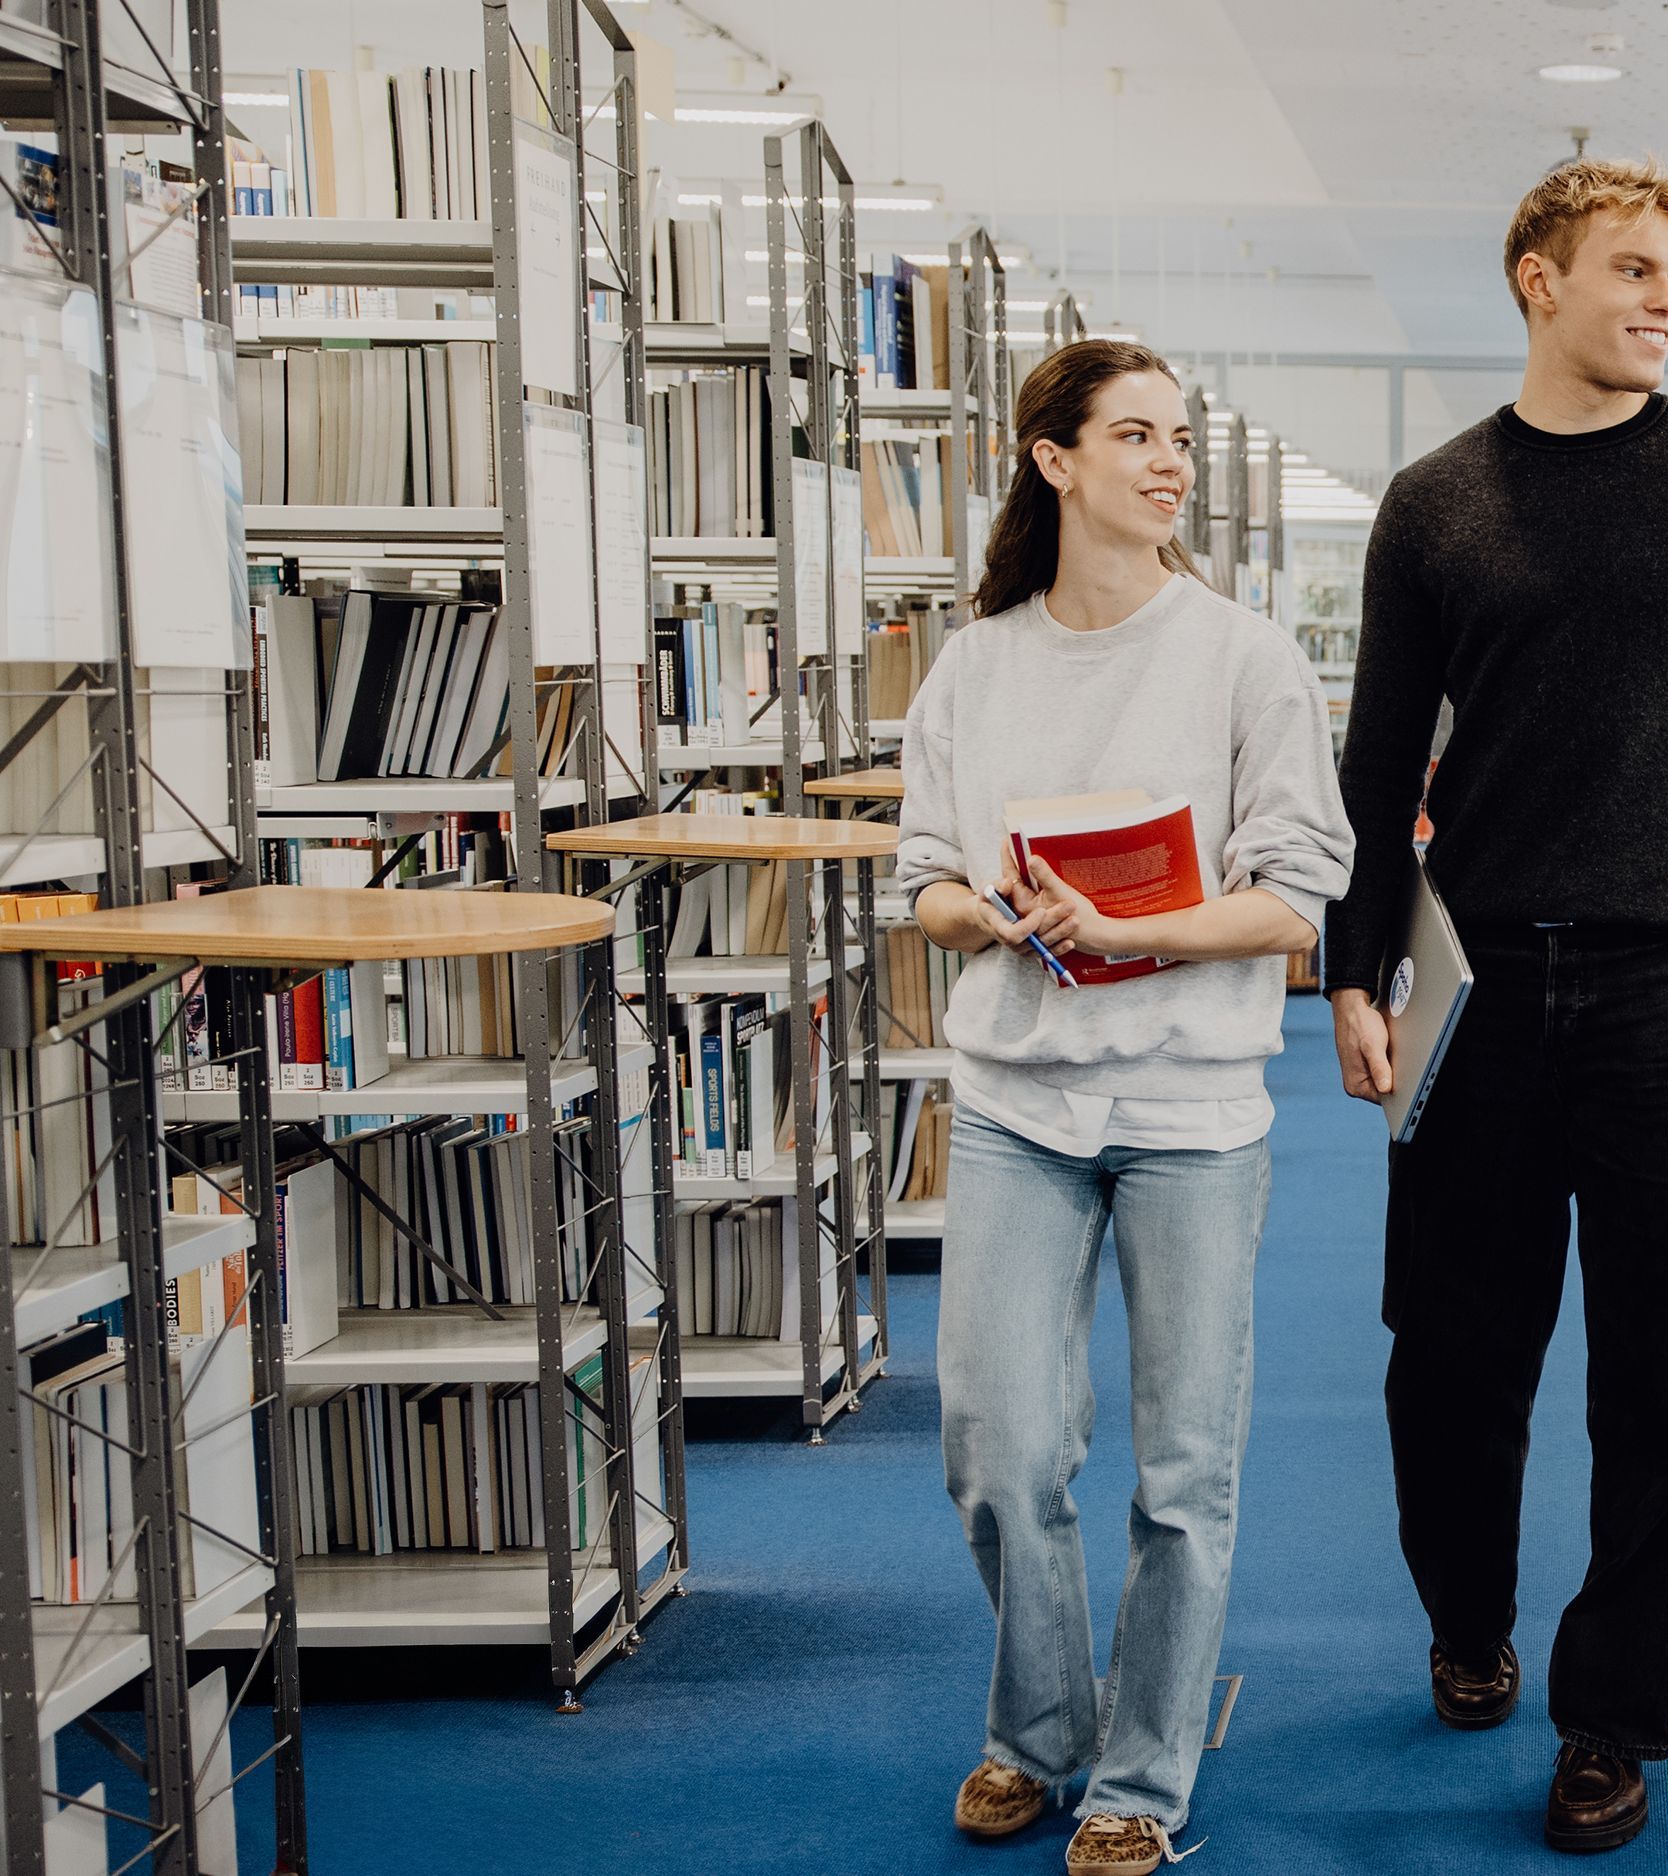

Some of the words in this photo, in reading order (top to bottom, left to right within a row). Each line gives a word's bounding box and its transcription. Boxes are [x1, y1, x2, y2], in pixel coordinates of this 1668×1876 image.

[526, 165, 566, 197] FREIHAND
[659, 650, 670, 716] SCHWIMMBÄDER
[707, 1068, 719, 1100] SPORTS
[708, 1102, 720, 1132] FIELDS
[275, 1194, 283, 1222] SPORT
[166, 1278, 178, 1326] BODIES
